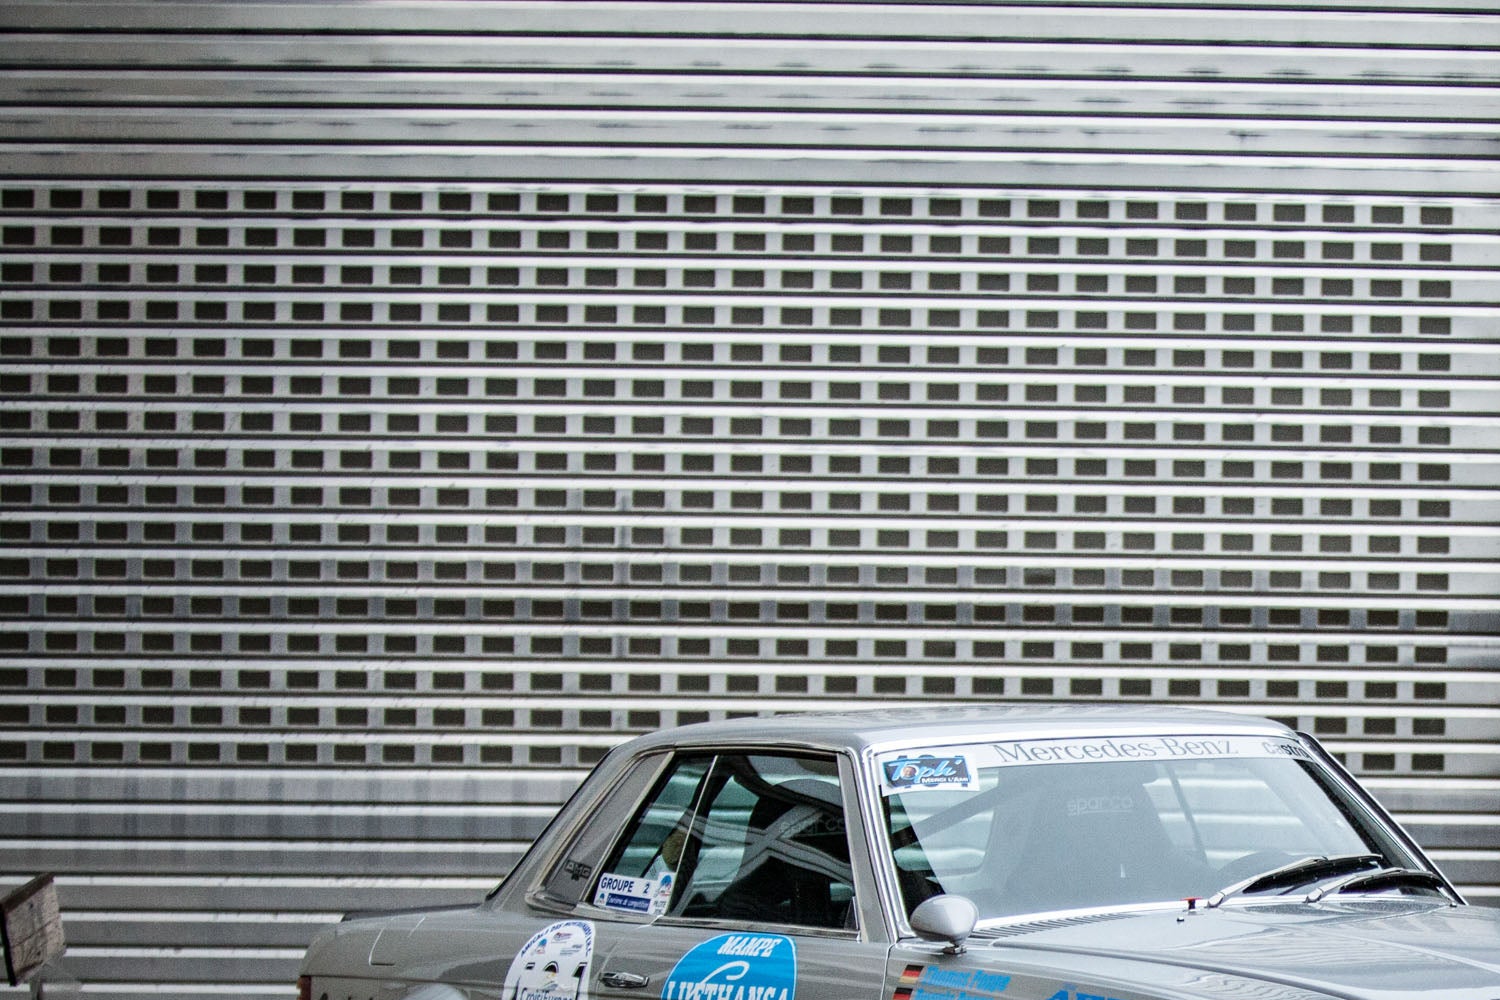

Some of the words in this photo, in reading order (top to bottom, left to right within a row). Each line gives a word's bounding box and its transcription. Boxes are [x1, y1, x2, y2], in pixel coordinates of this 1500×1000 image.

[993, 738, 1239, 763] Mercedes-Benz
[601, 877, 634, 893] GROUPE
[643, 883, 651, 895] 2
[717, 935, 782, 958] MAMPE
